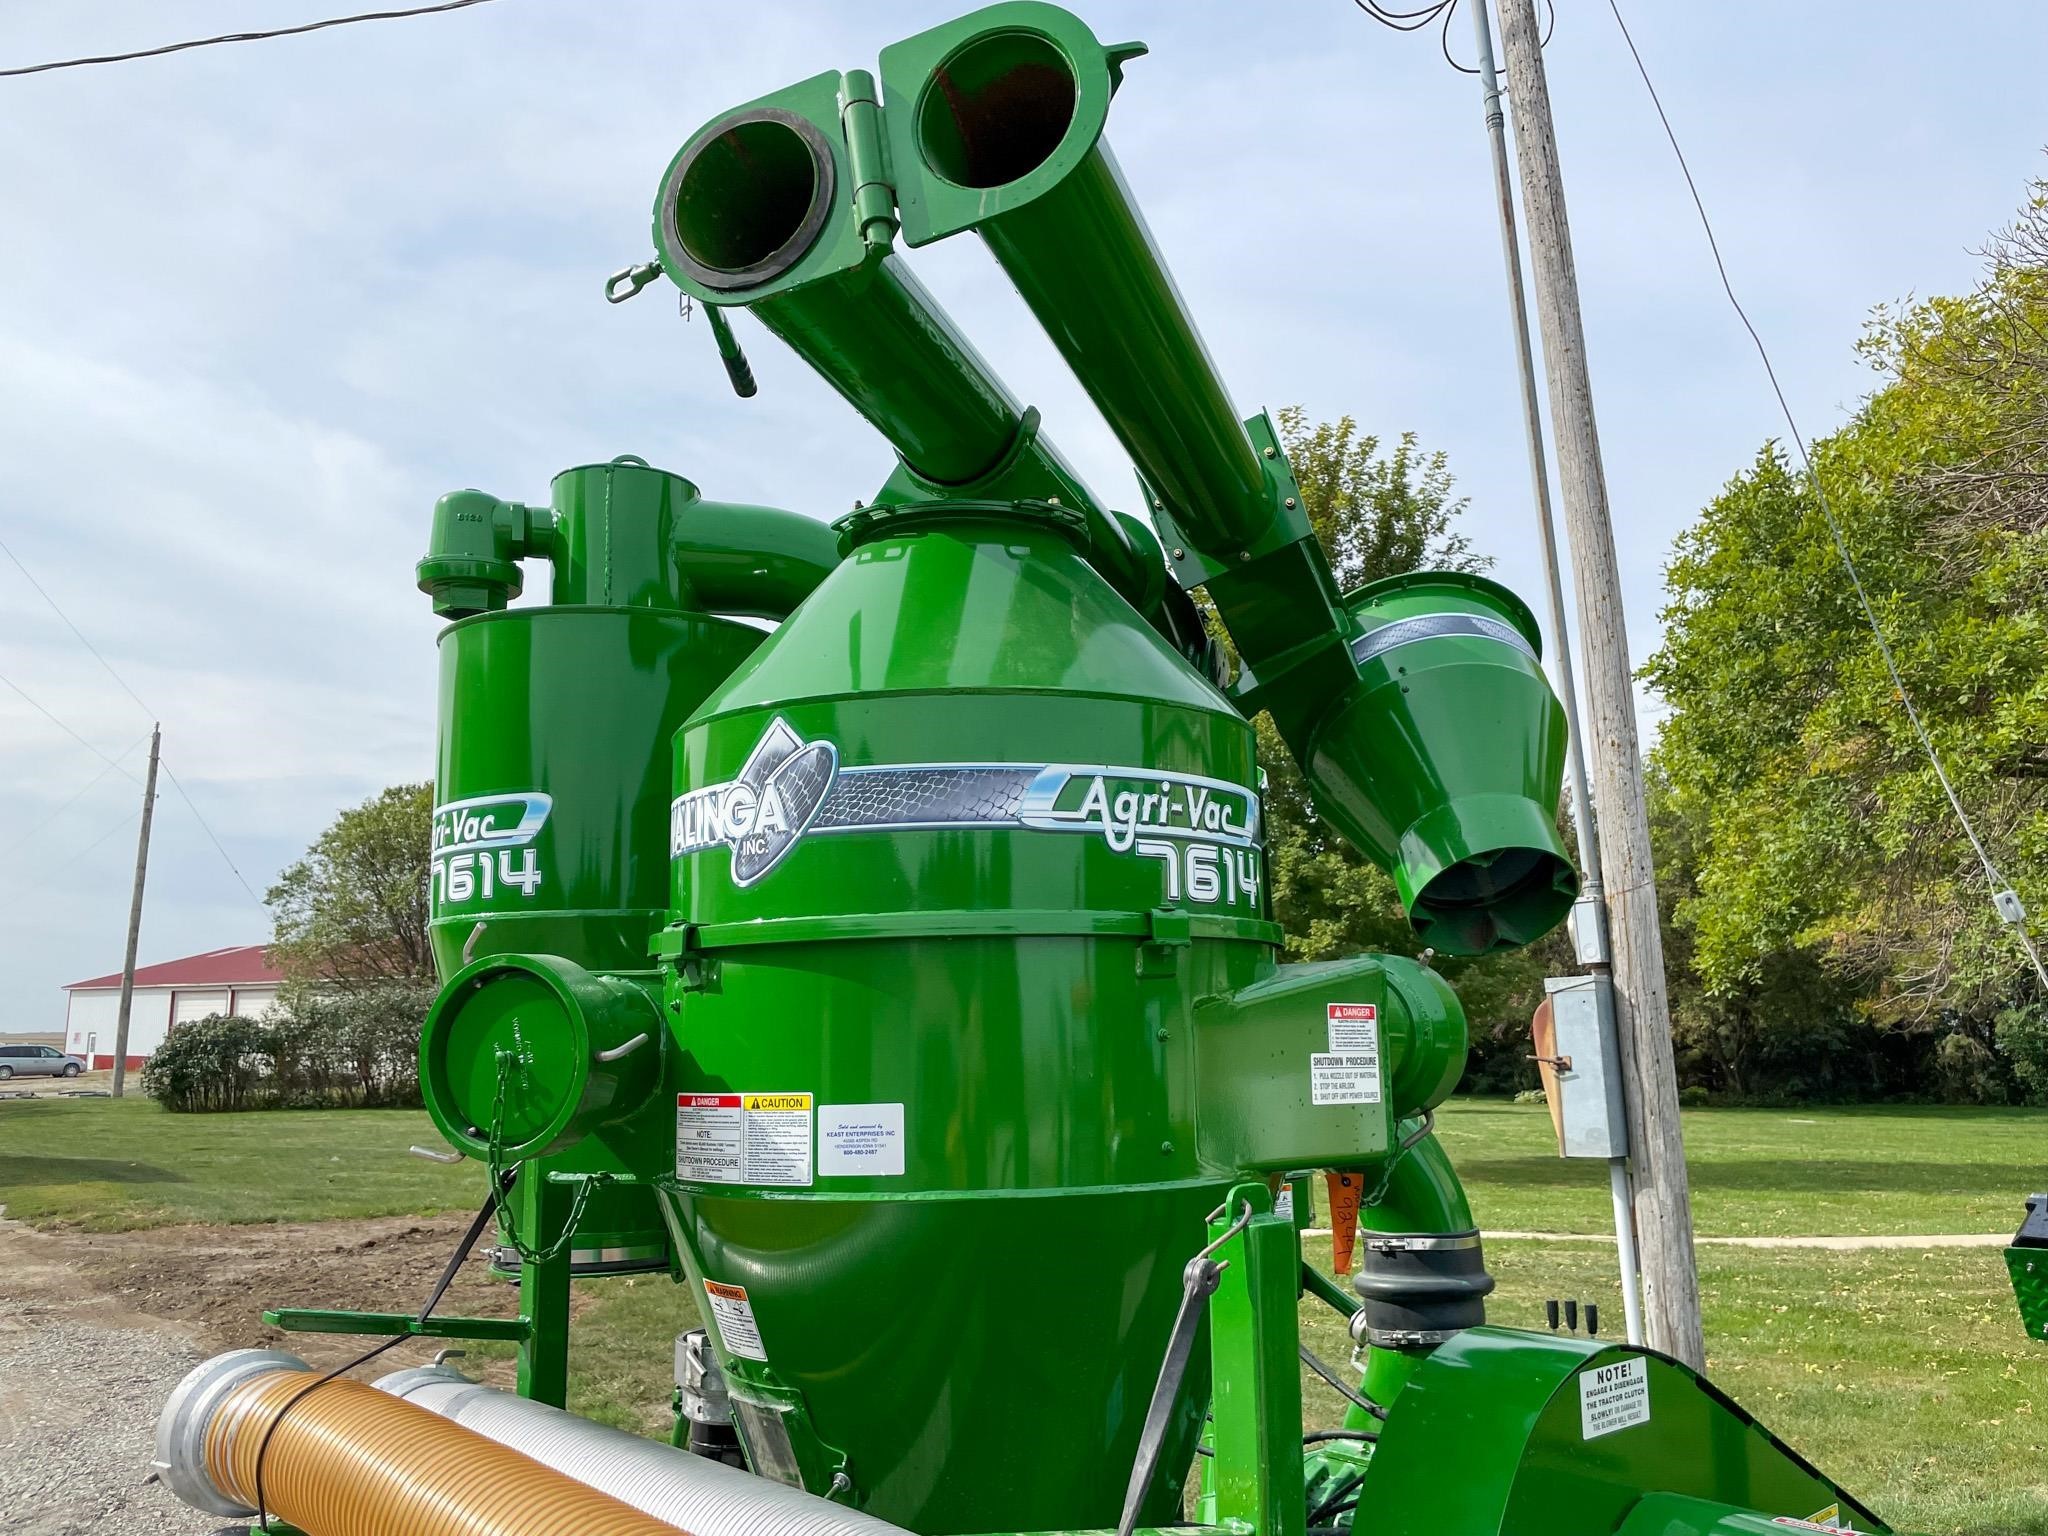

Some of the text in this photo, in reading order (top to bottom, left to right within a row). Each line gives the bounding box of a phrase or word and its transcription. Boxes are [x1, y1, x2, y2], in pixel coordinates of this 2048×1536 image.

[1079, 775, 1236, 853] Agri-Vac
[742, 839, 769, 856] INC.
[1135, 838, 1258, 909] 7614
[1342, 1007, 1371, 1017] DANGER
[1313, 1056, 1377, 1066] SHUTDOWN PROCEDURE
[696, 1096, 720, 1107] DANGER
[761, 1097, 804, 1109] CAUTION
[678, 1155, 740, 1167] SHUTDOWN PROCEDURE
[1597, 1363, 1632, 1385] NOTE!
[1586, 1386, 1608, 1398] ENGAGE
[1614, 1376, 1643, 1390] DISENGAGE
[1586, 1387, 1645, 1410] THE TRACTOR CLUTCH
